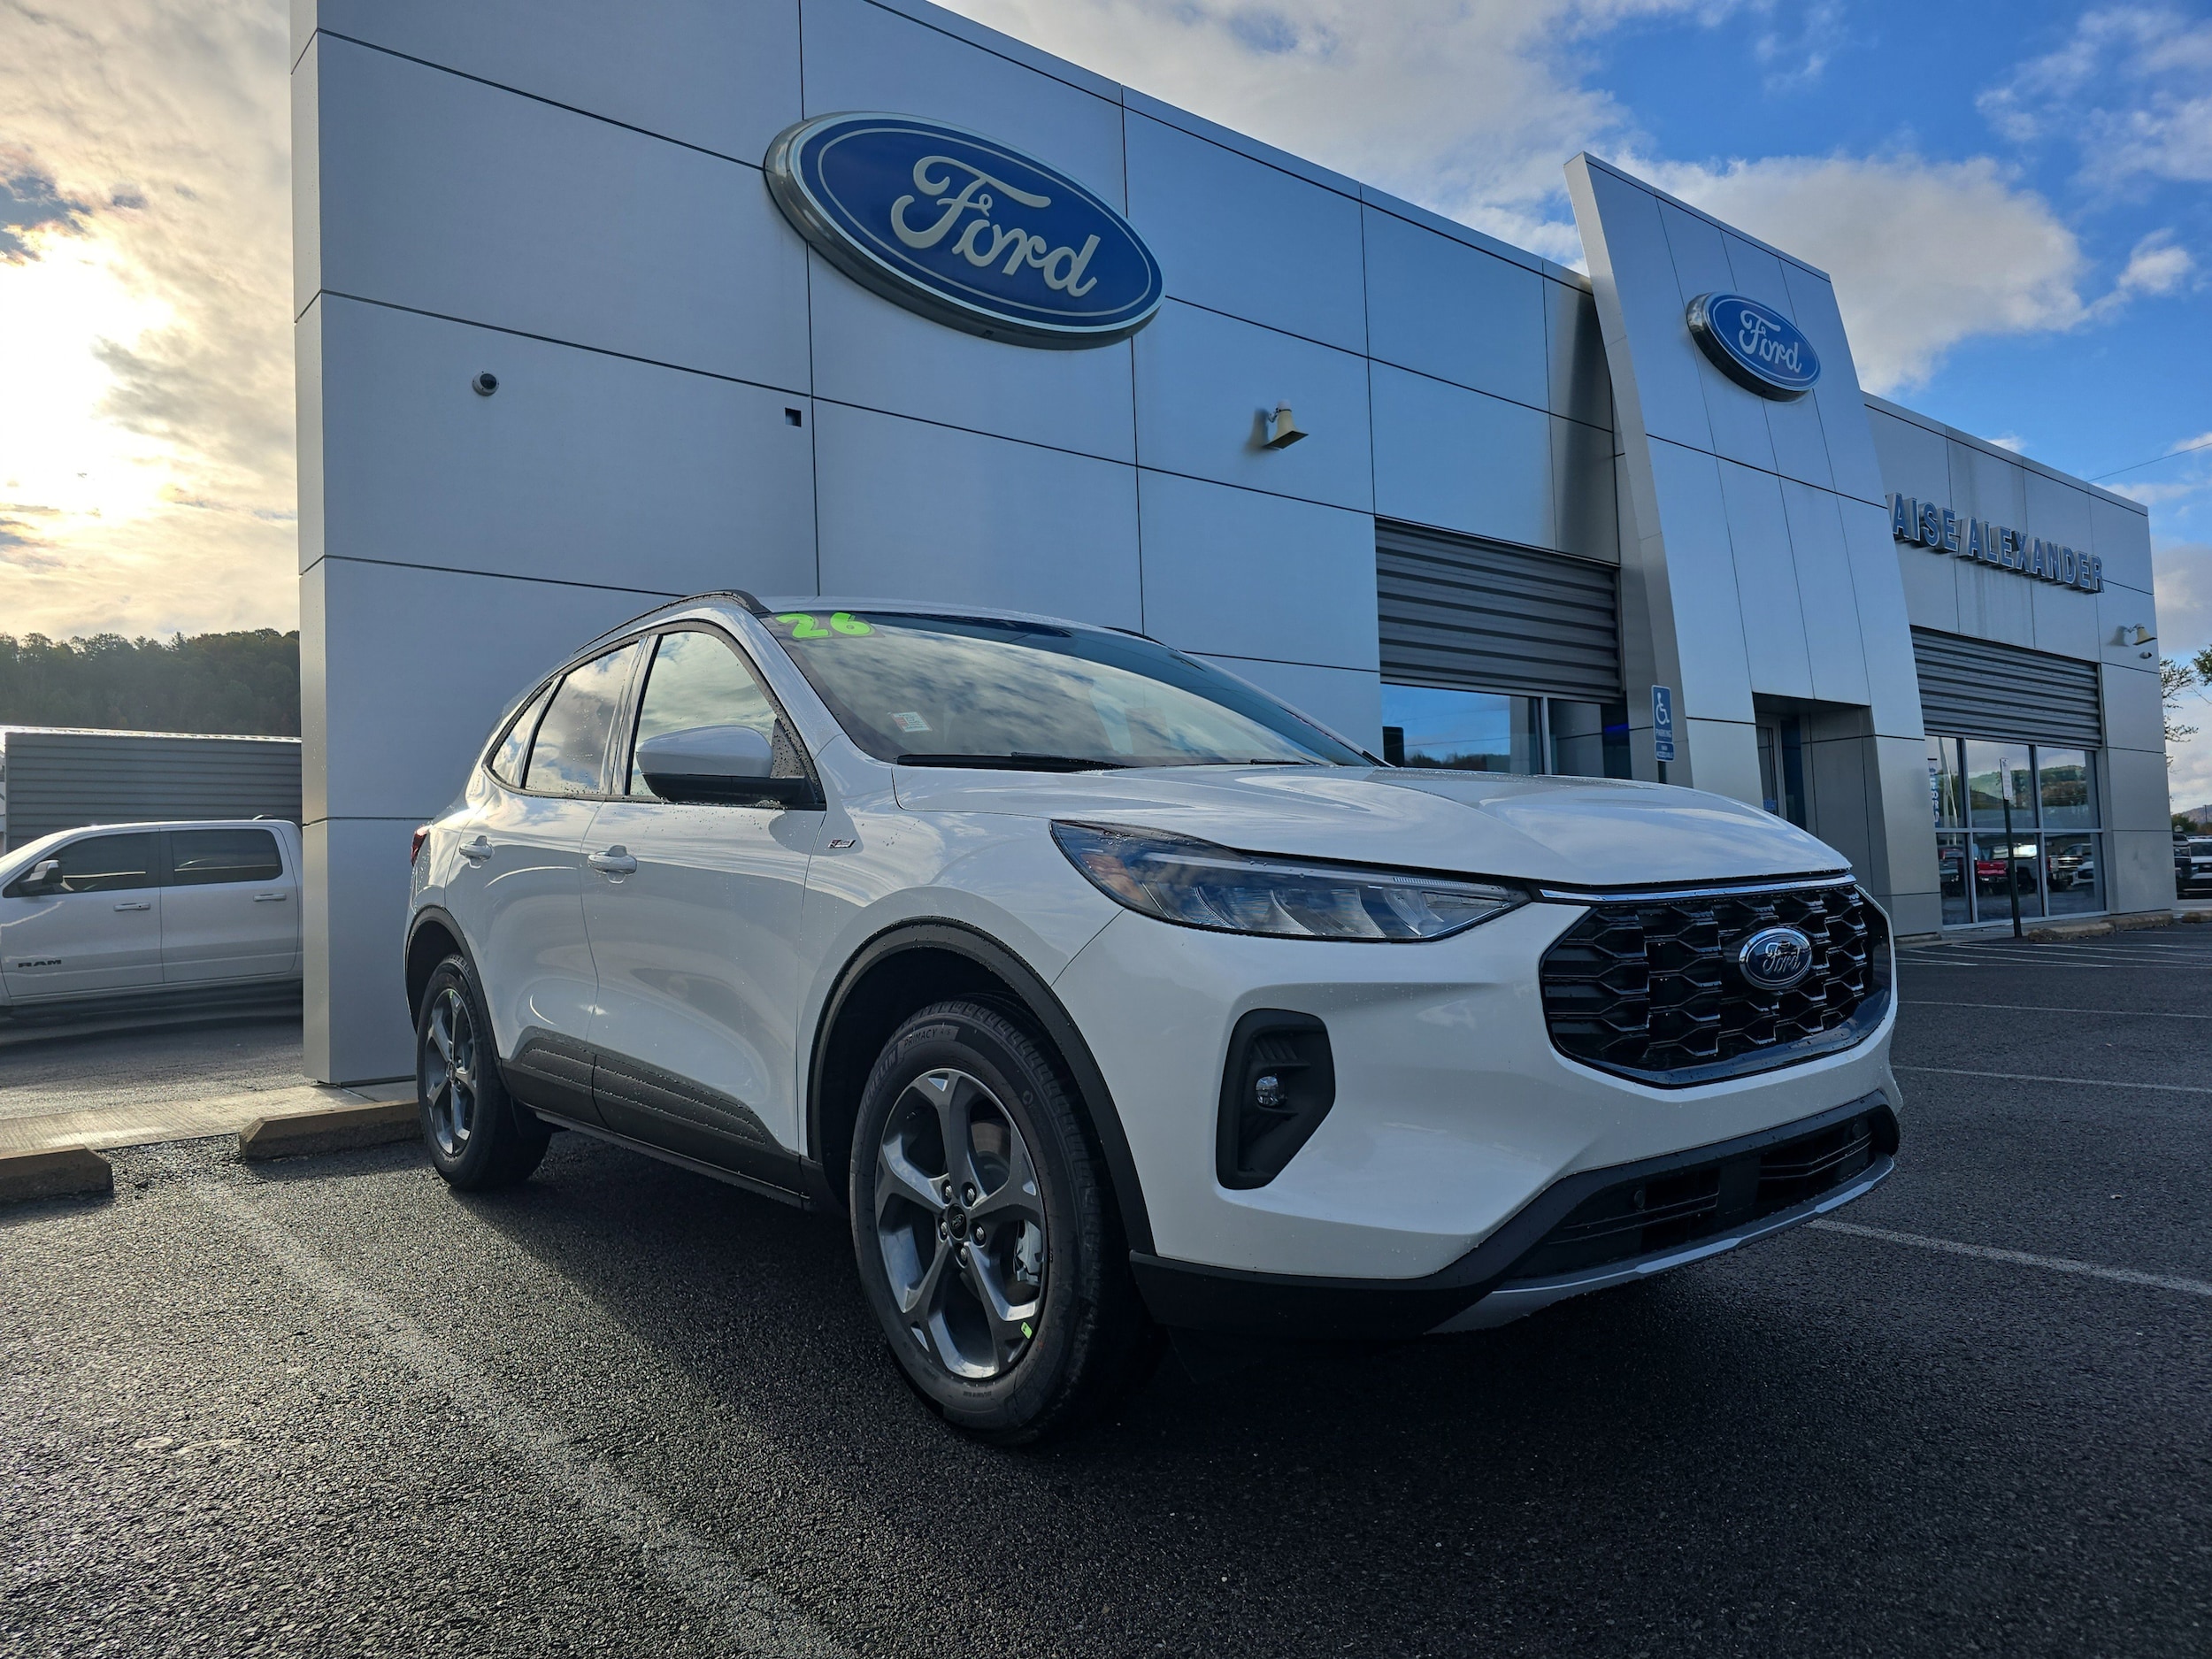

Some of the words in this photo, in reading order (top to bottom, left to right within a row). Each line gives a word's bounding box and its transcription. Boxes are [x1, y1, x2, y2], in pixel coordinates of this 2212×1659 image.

[891, 155, 1100, 297] Ford
[1739, 310, 1801, 373] Ford
[1964, 517, 2104, 593] ALEXANDER
[775, 611, 874, 640] 26
[18, 959, 62, 968] RAM
[1763, 941, 1801, 974] Ford
[903, 1028, 938, 1048] PRIMACY
